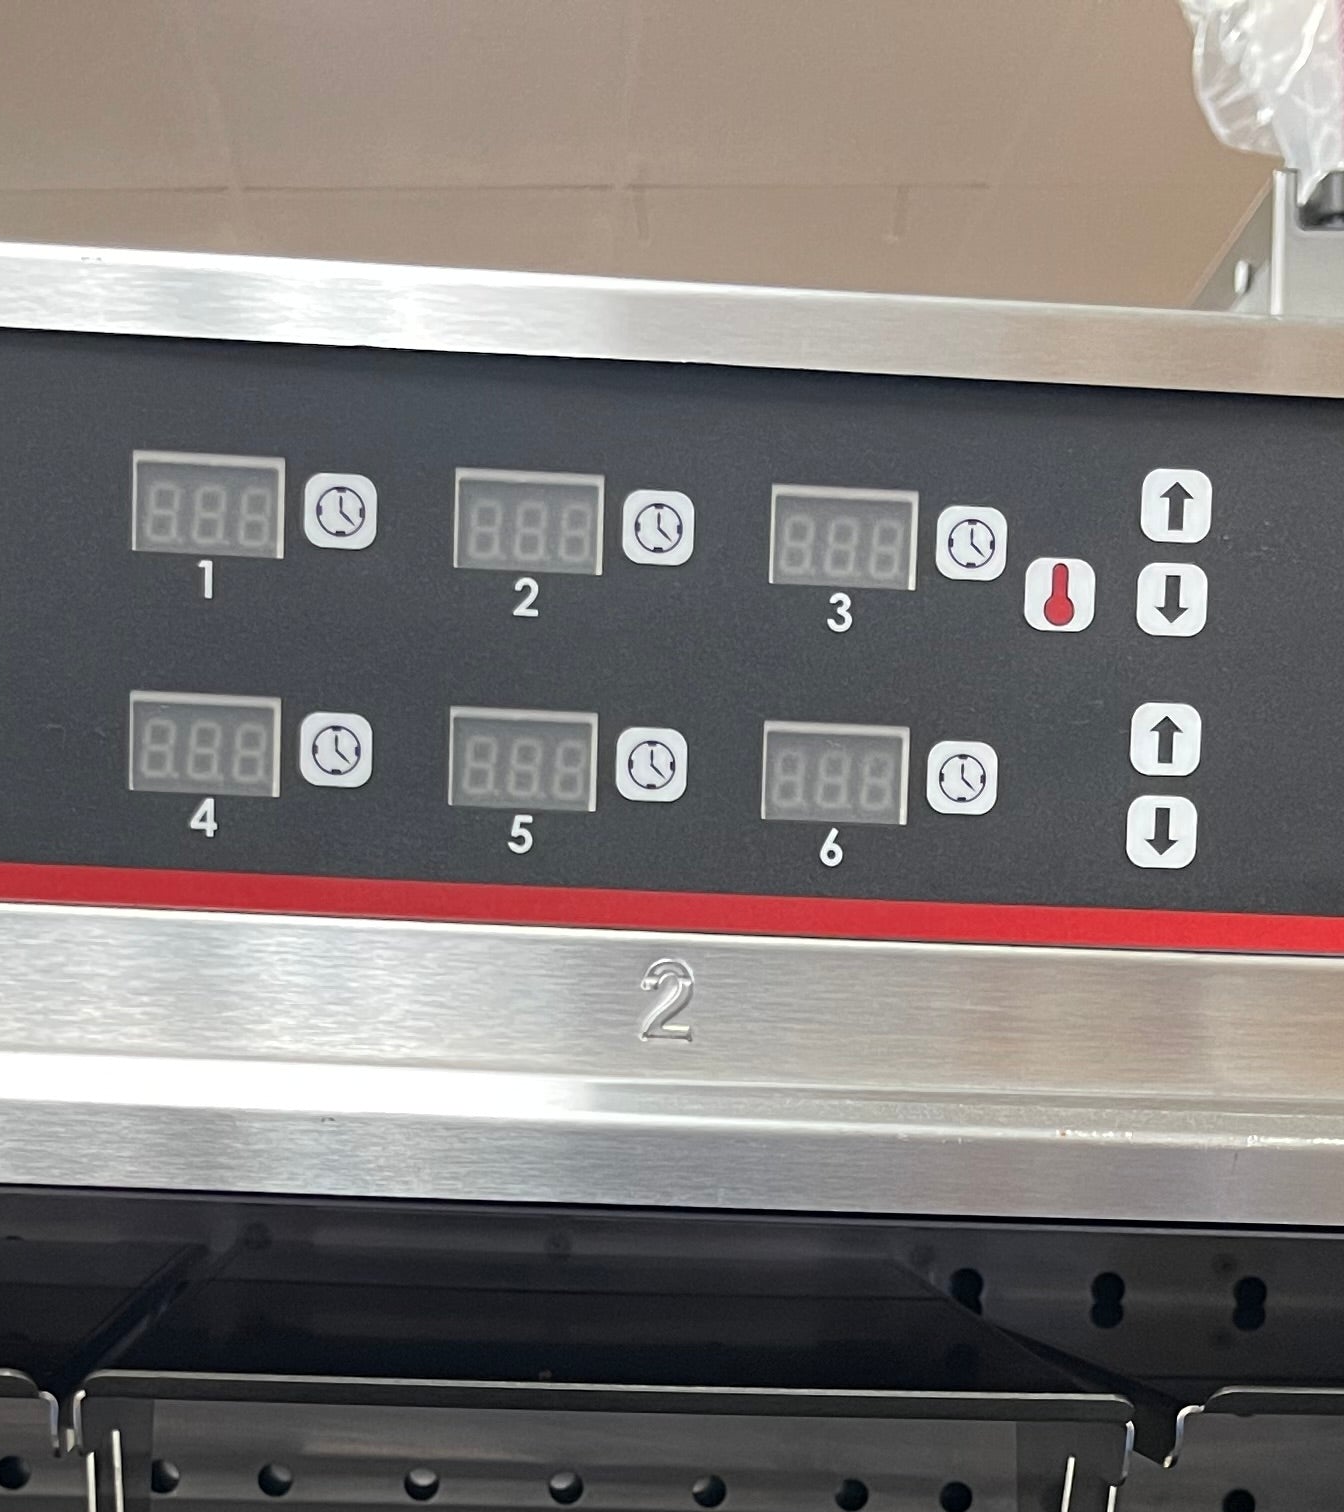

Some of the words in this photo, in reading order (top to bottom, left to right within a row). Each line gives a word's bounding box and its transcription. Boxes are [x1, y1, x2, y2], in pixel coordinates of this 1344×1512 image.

[196, 558, 214, 600] 1
[512, 576, 541, 618] 2
[826, 591, 854, 634] 3
[189, 797, 219, 839] 4
[507, 814, 534, 855] 5
[819, 827, 845, 868] 6
[638, 957, 695, 1043] 2
